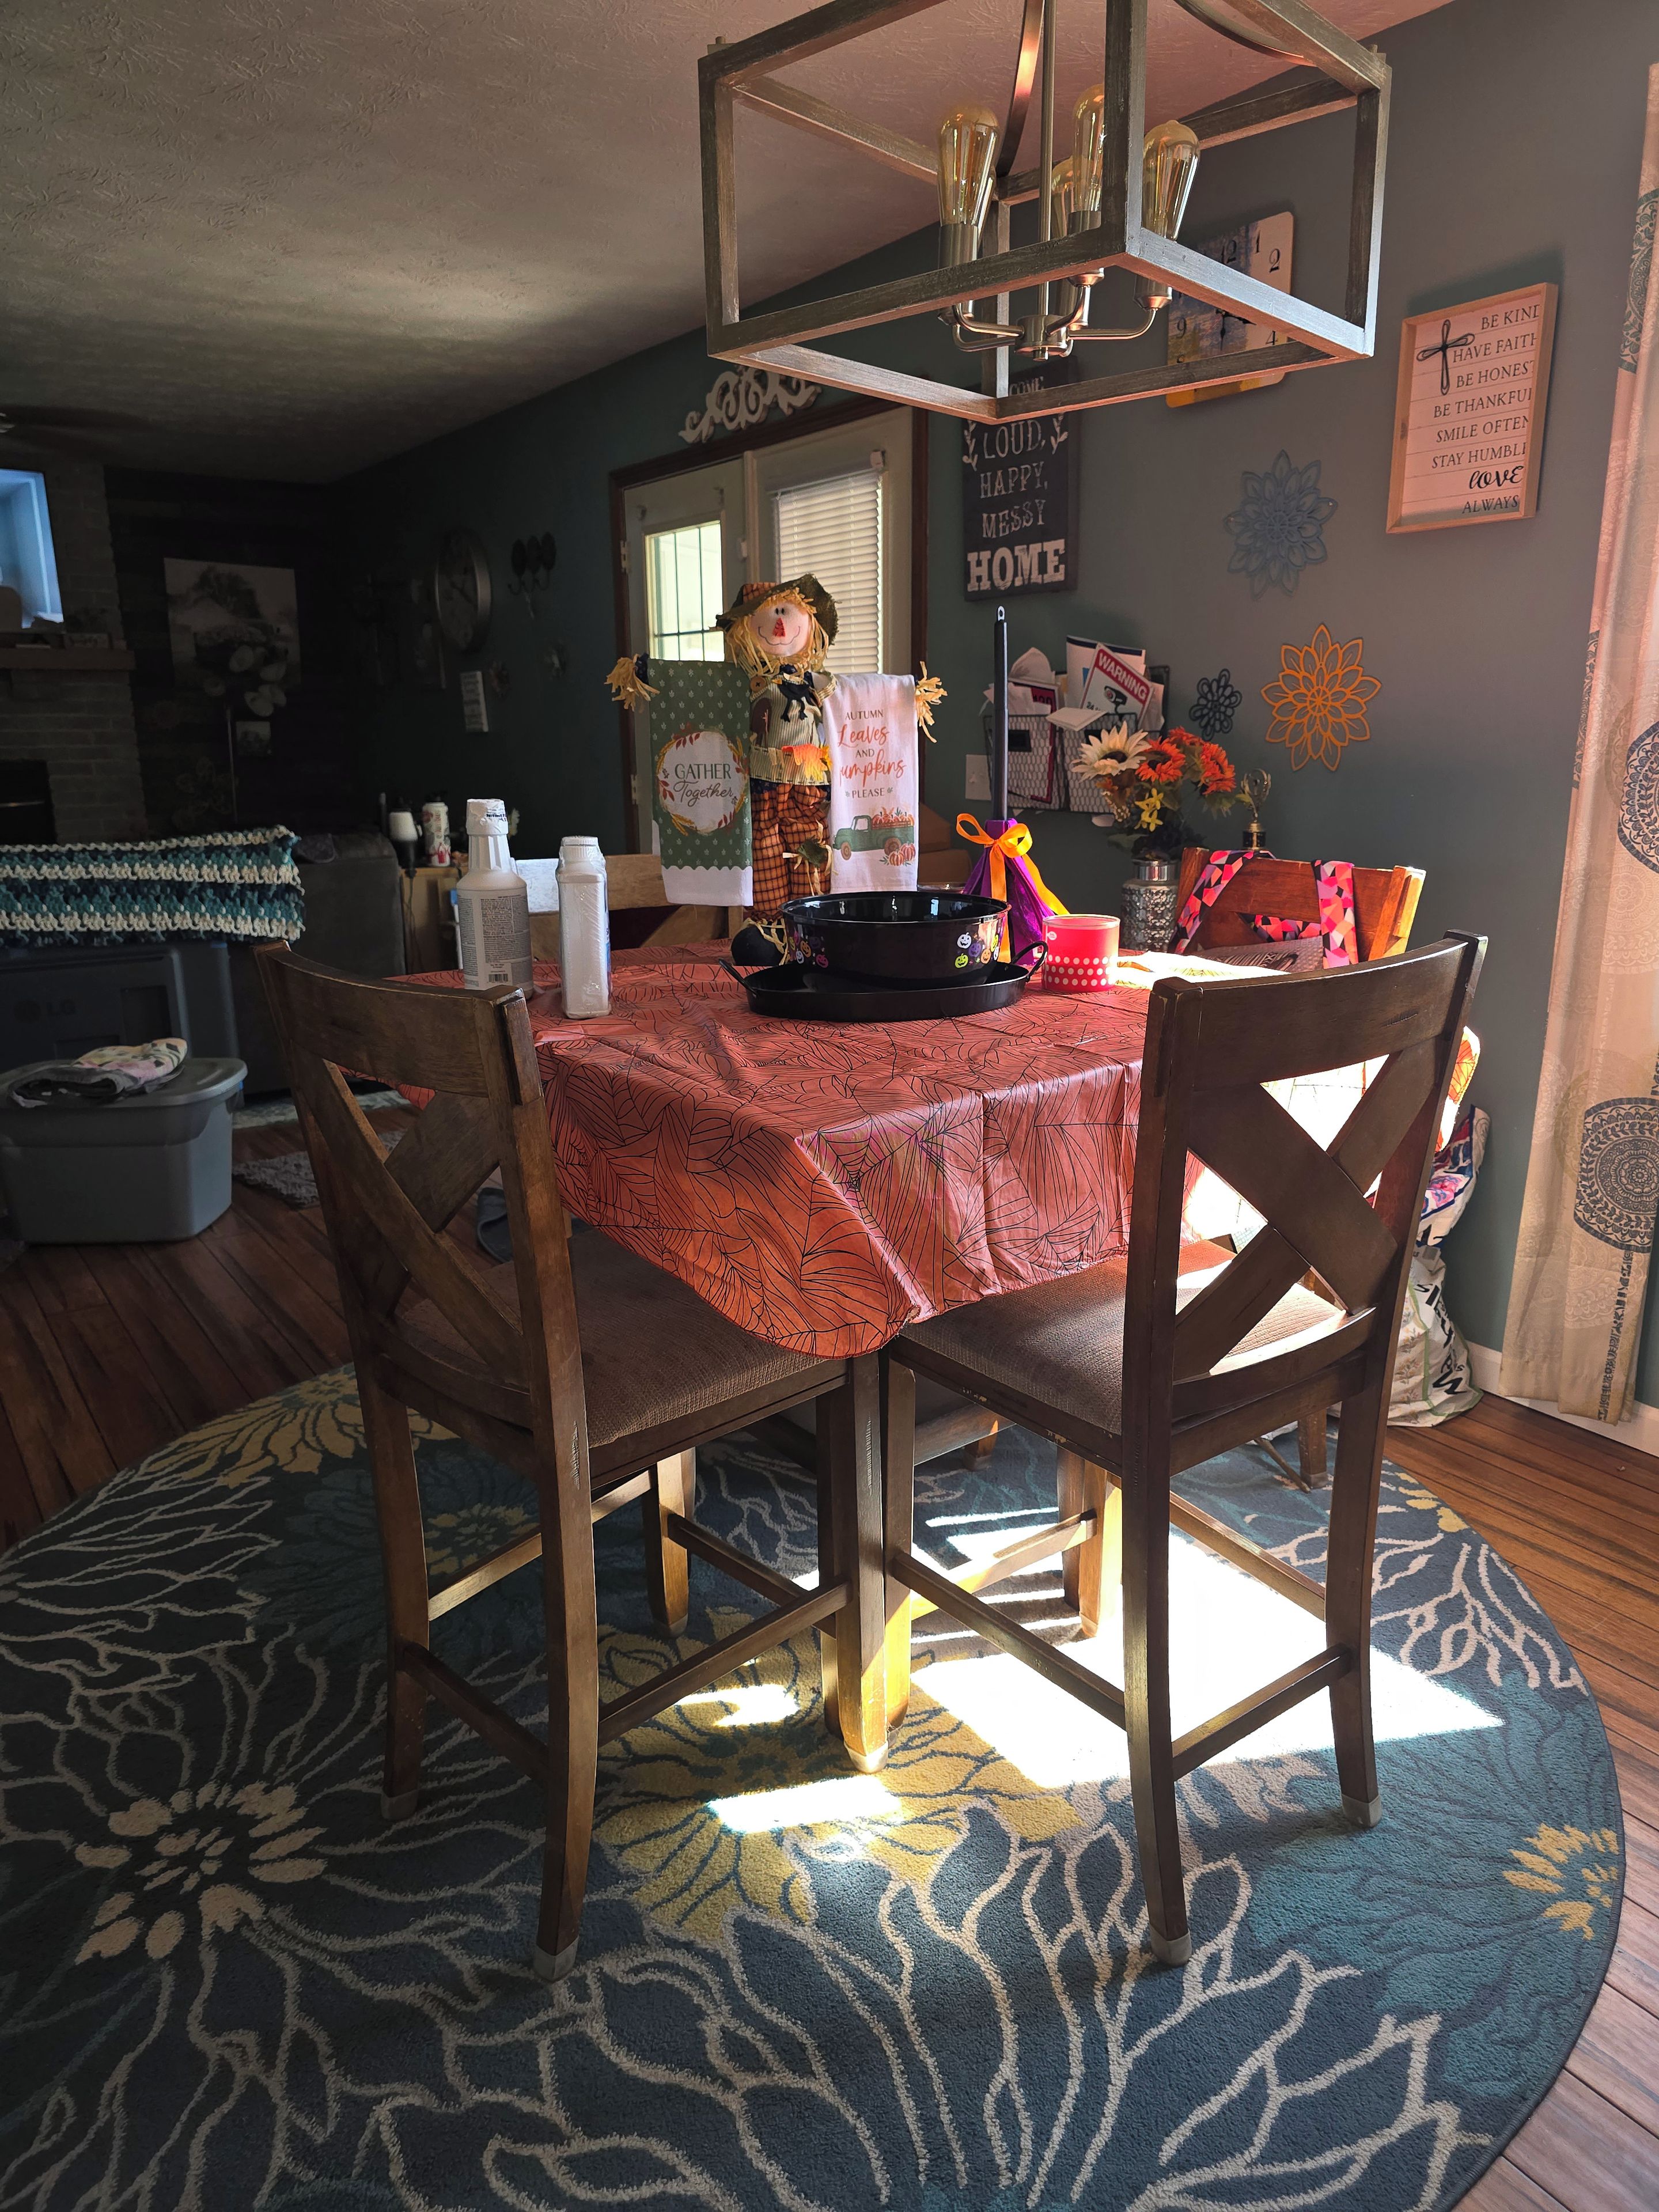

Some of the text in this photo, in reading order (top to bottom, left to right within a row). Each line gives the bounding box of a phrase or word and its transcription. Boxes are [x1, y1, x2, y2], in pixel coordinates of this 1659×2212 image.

[1269, 248, 1281, 272] 2
[1481, 313, 1498, 330] BE
[1453, 342, 1491, 363] HAVE
[1456, 370, 1474, 388] BE
[1434, 402, 1451, 419] BE
[983, 419, 1046, 459] LOUD,
[1436, 423, 1478, 444] SMILE
[1431, 451, 1464, 470] STAY
[980, 461, 1048, 499] HAPPY,
[1462, 494, 1519, 514] ALWAYS
[982, 499, 1046, 539] MESSY
[967, 539, 1066, 592] HOME
[1099, 653, 1146, 700] WARNING
[845, 710, 884, 721] AUTUMN
[838, 724, 890, 748] Leaves
[855, 748, 876, 758] AND
[675, 764, 731, 780] GATHER
[673, 779, 734, 807] Together
[852, 787, 886, 799] PLEASE
